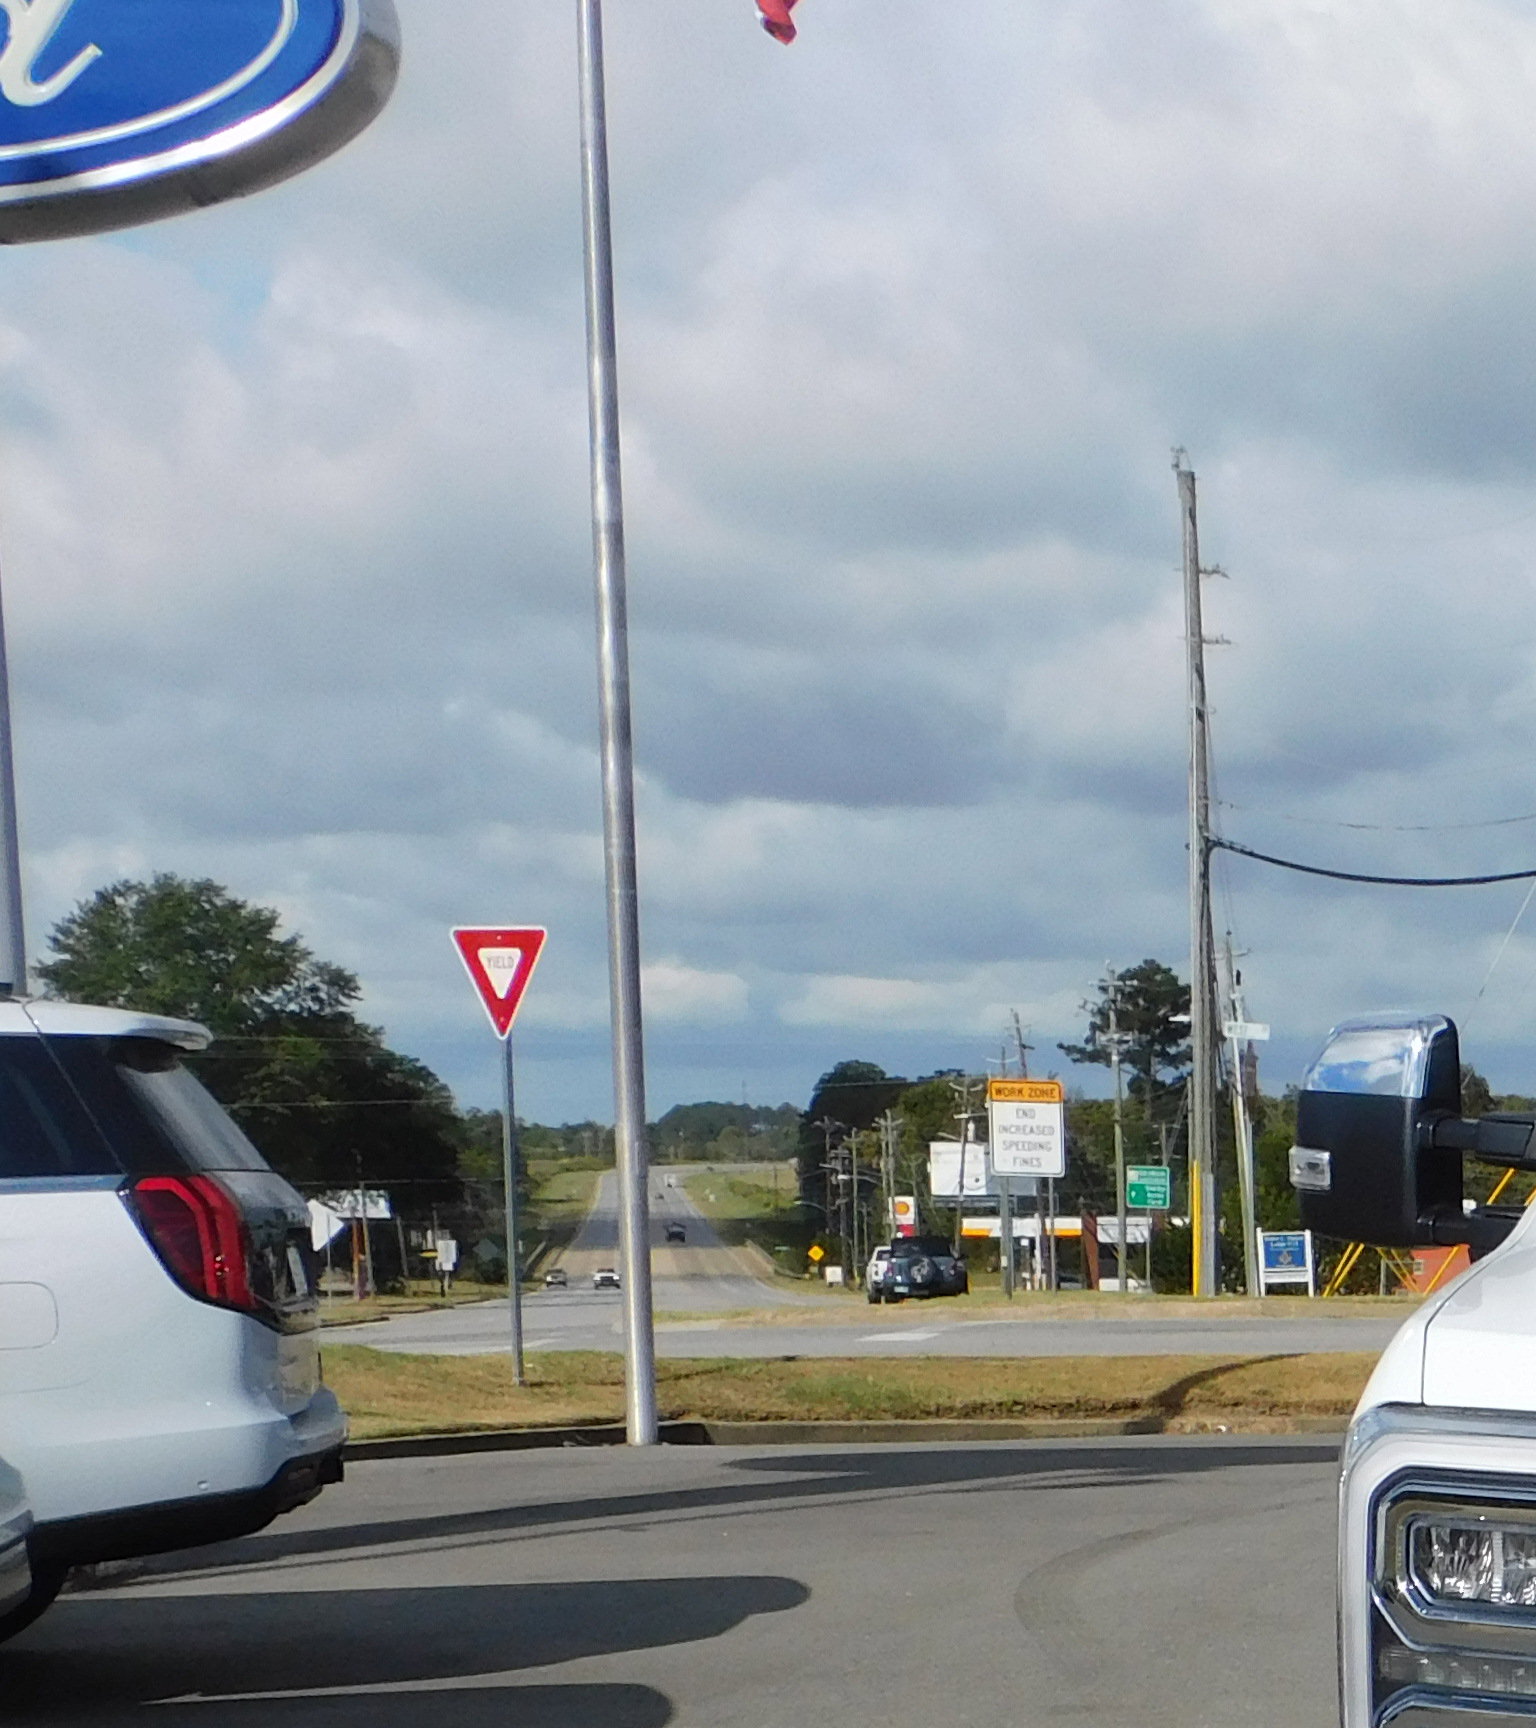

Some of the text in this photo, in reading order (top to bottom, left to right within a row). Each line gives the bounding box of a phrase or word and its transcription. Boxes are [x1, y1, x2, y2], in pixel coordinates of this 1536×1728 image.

[486, 955, 515, 969] YIELD
[994, 1086, 1057, 1099] WORK ZONE
[1015, 1107, 1036, 1120] END
[998, 1124, 1055, 1137] INCREASED
[1001, 1140, 1053, 1153] SPEEDING
[1012, 1156, 1042, 1168] FINES
